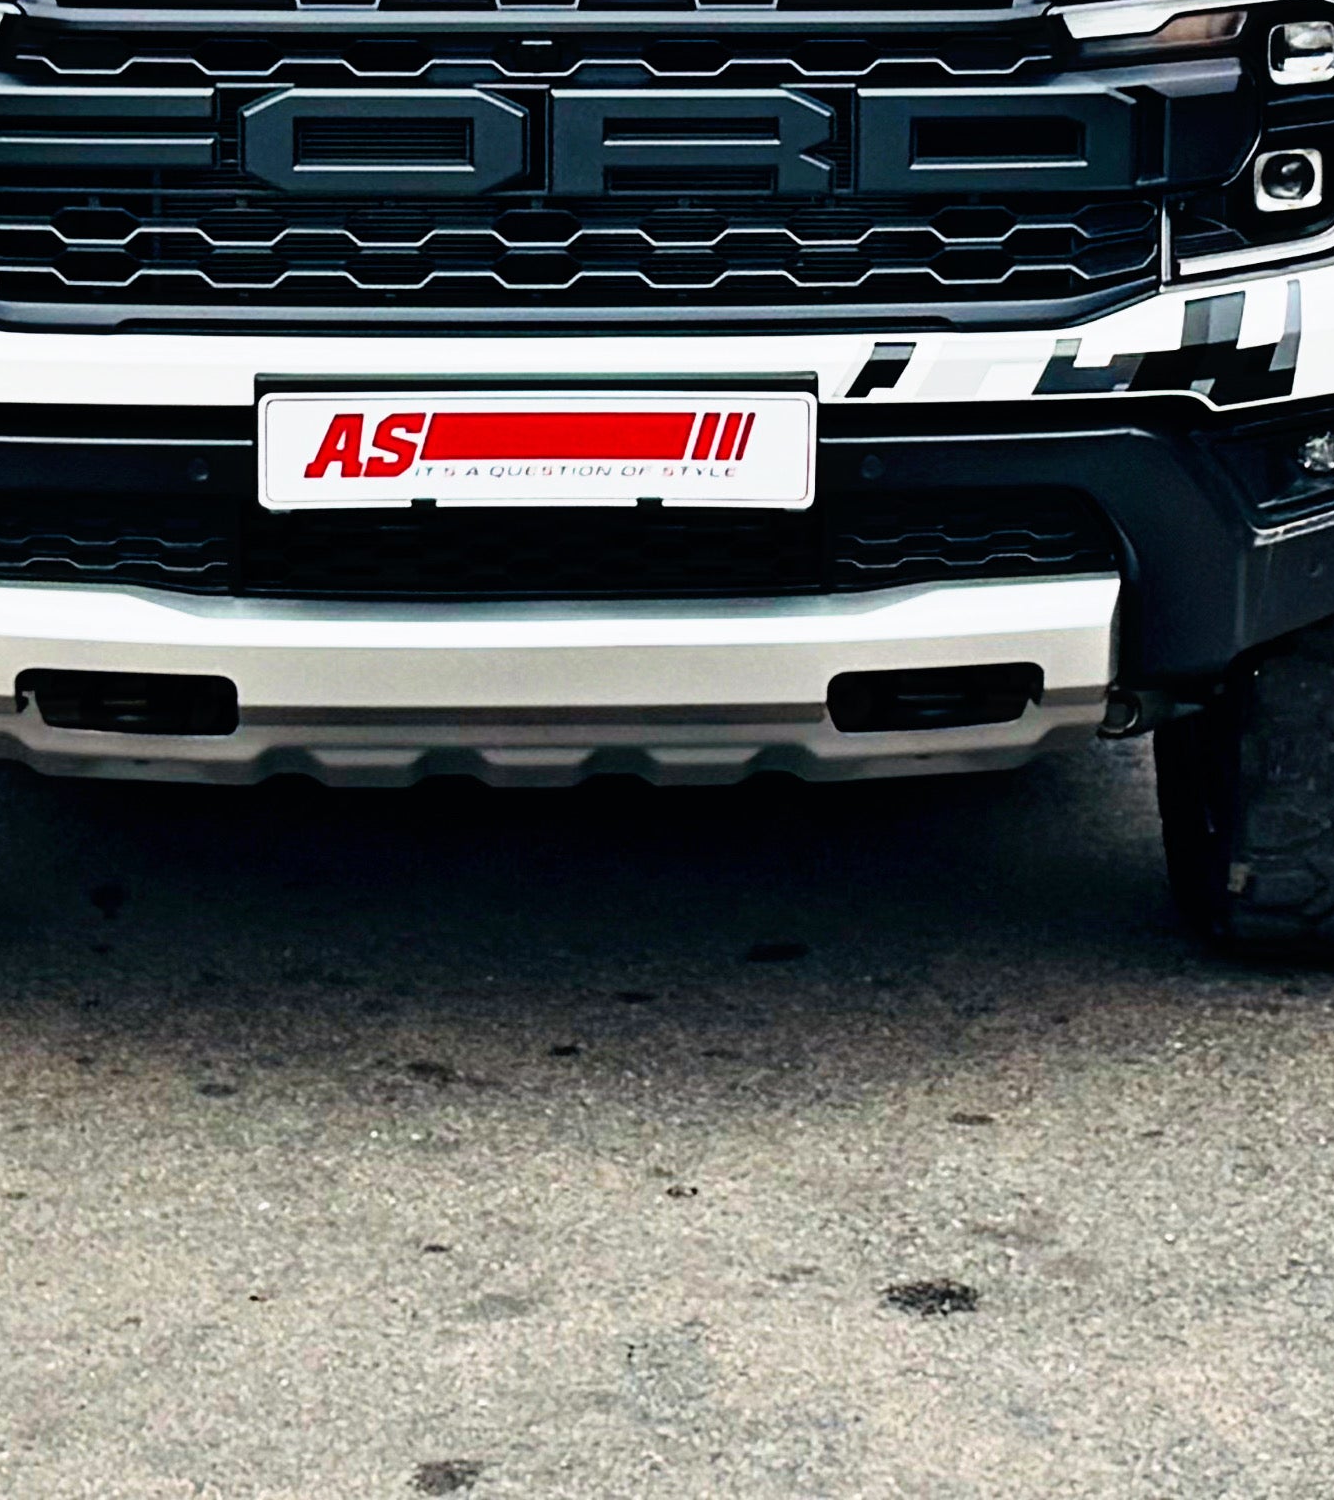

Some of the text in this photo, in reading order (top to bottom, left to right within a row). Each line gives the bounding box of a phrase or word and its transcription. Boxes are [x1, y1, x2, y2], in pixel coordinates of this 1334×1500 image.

[304, 412, 426, 478] AS
[415, 465, 736, 478] ITS A QUESTION OF STYLE
